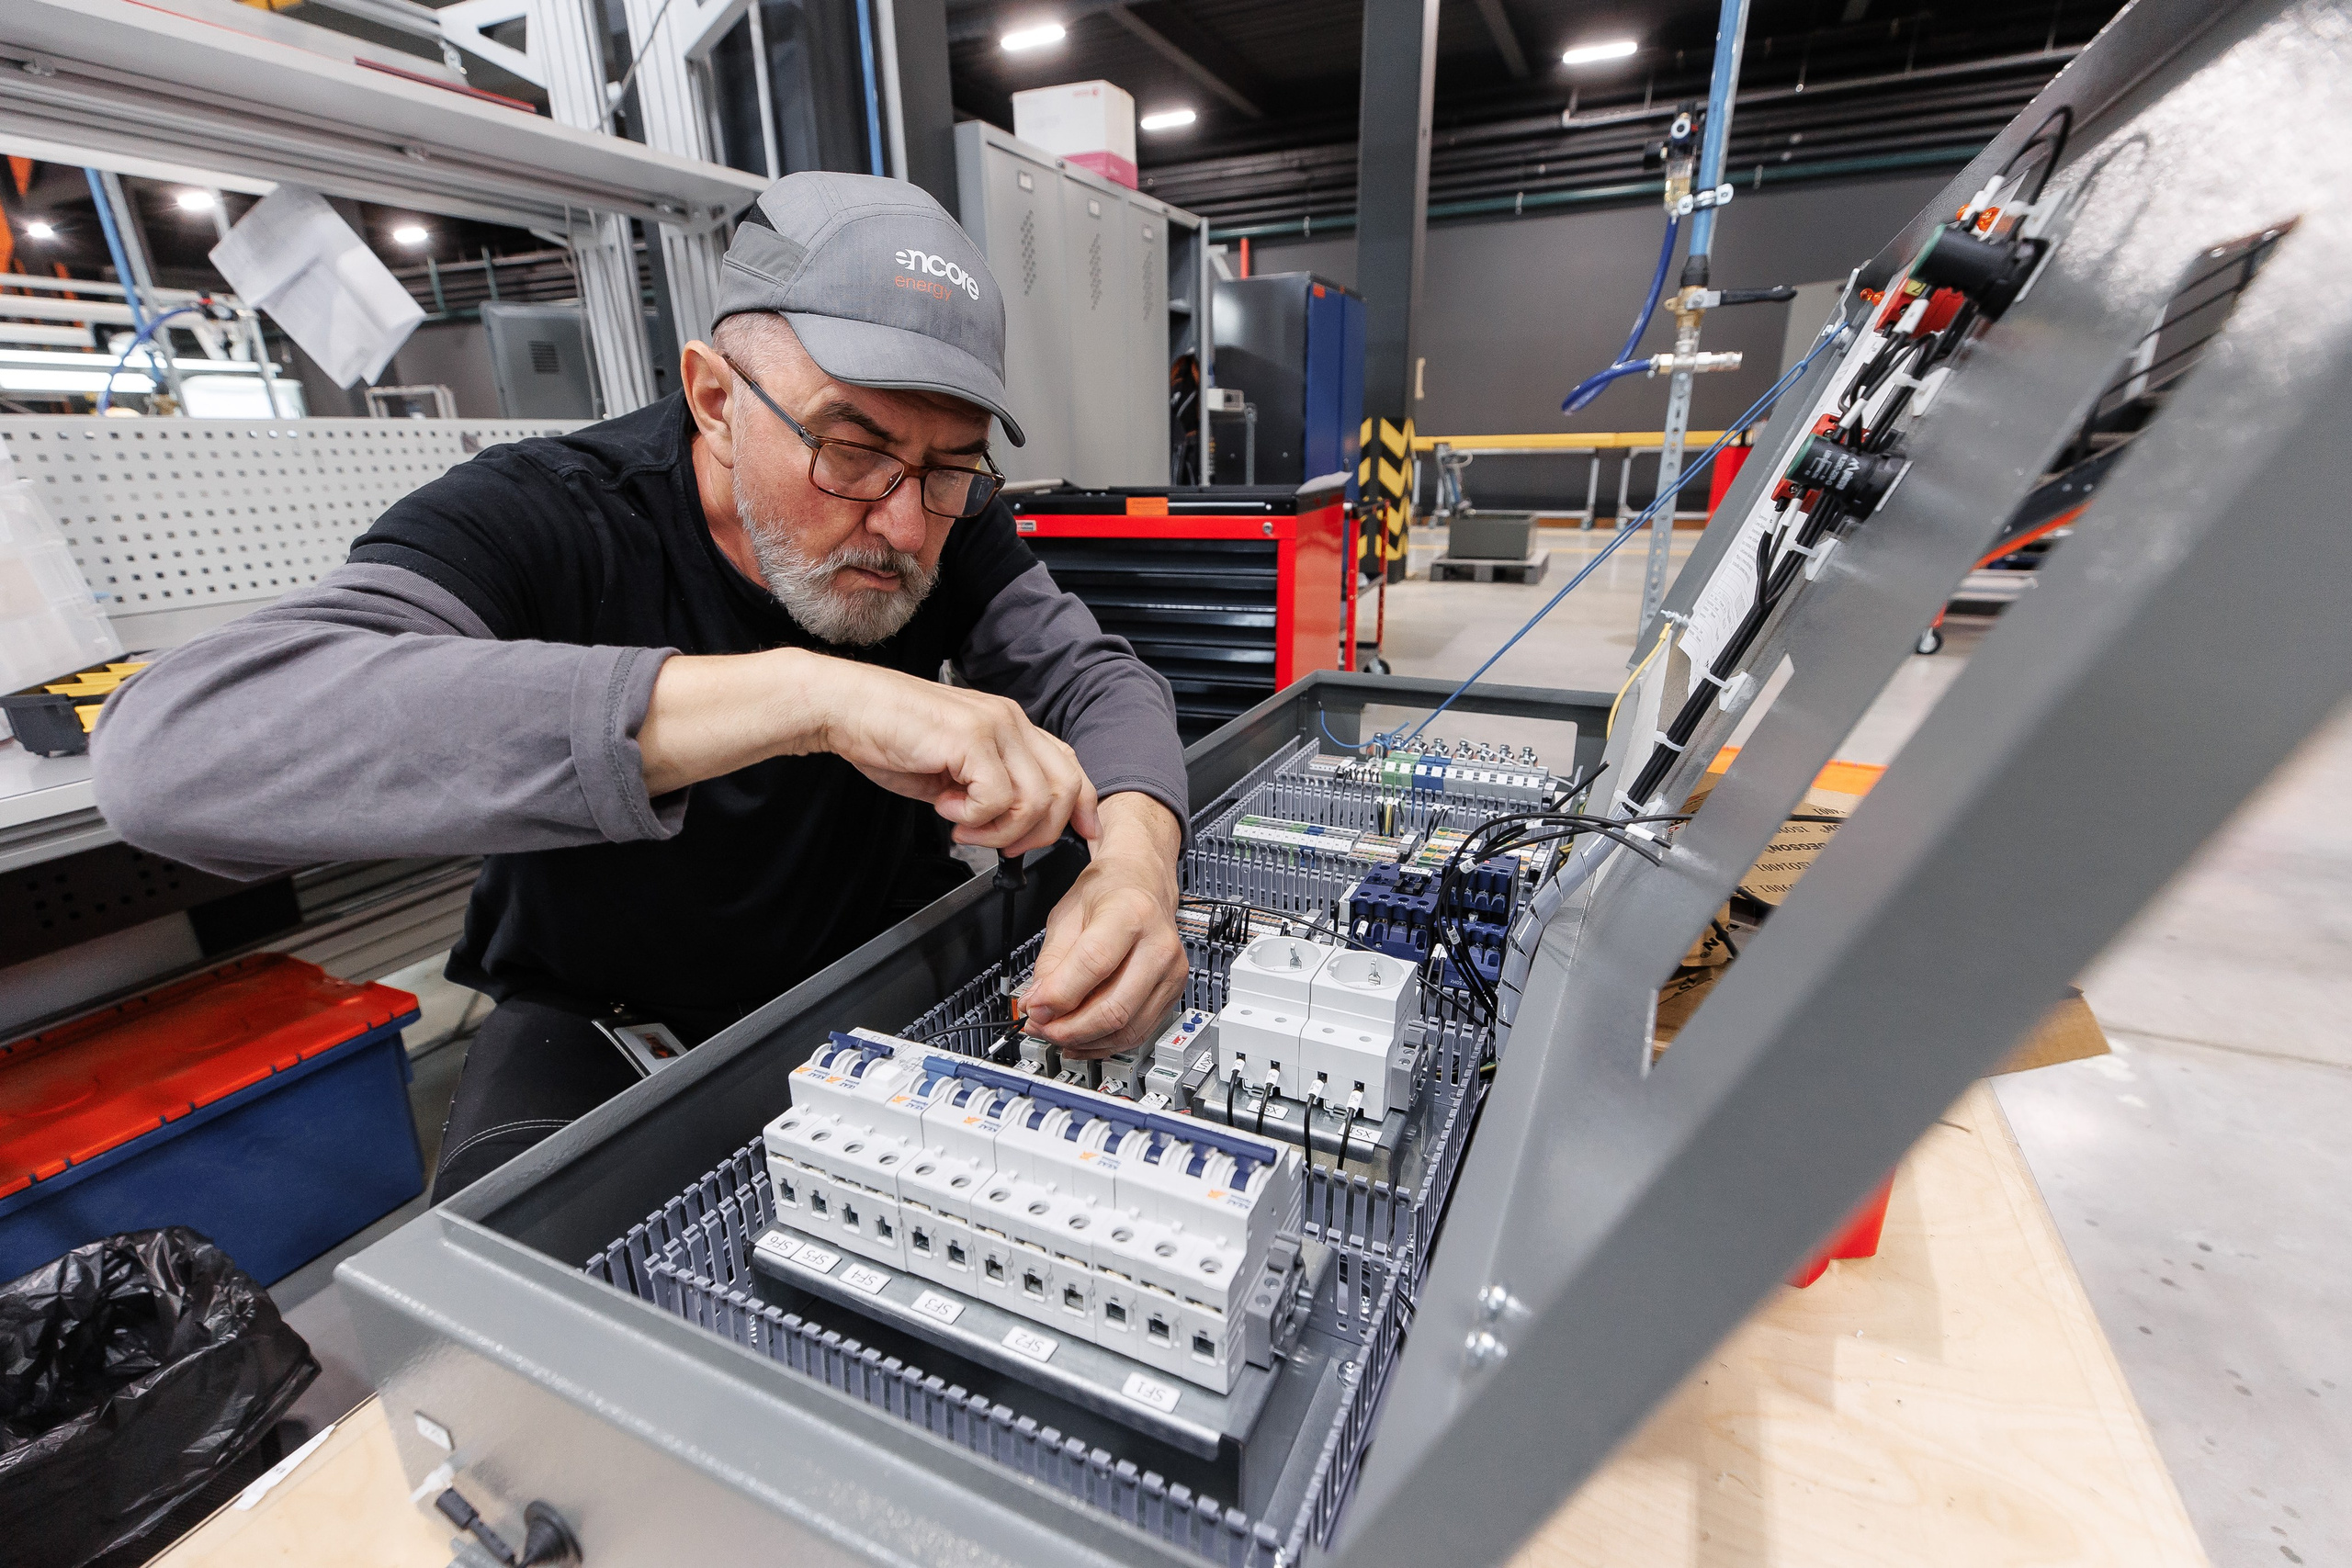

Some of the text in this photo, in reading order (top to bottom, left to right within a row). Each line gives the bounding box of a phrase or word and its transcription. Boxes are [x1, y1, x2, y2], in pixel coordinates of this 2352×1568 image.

[895, 248, 979, 300] encore
[894, 276, 953, 301] energy
[808, 1072, 826, 1080] KEAZ
[766, 1235, 793, 1250] SF6
[803, 1250, 829, 1265] SF5
[851, 1269, 877, 1286] SF4
[924, 1298, 953, 1315] SF3
[1015, 1333, 1045, 1352] SF2
[1137, 1381, 1167, 1402] SF1
